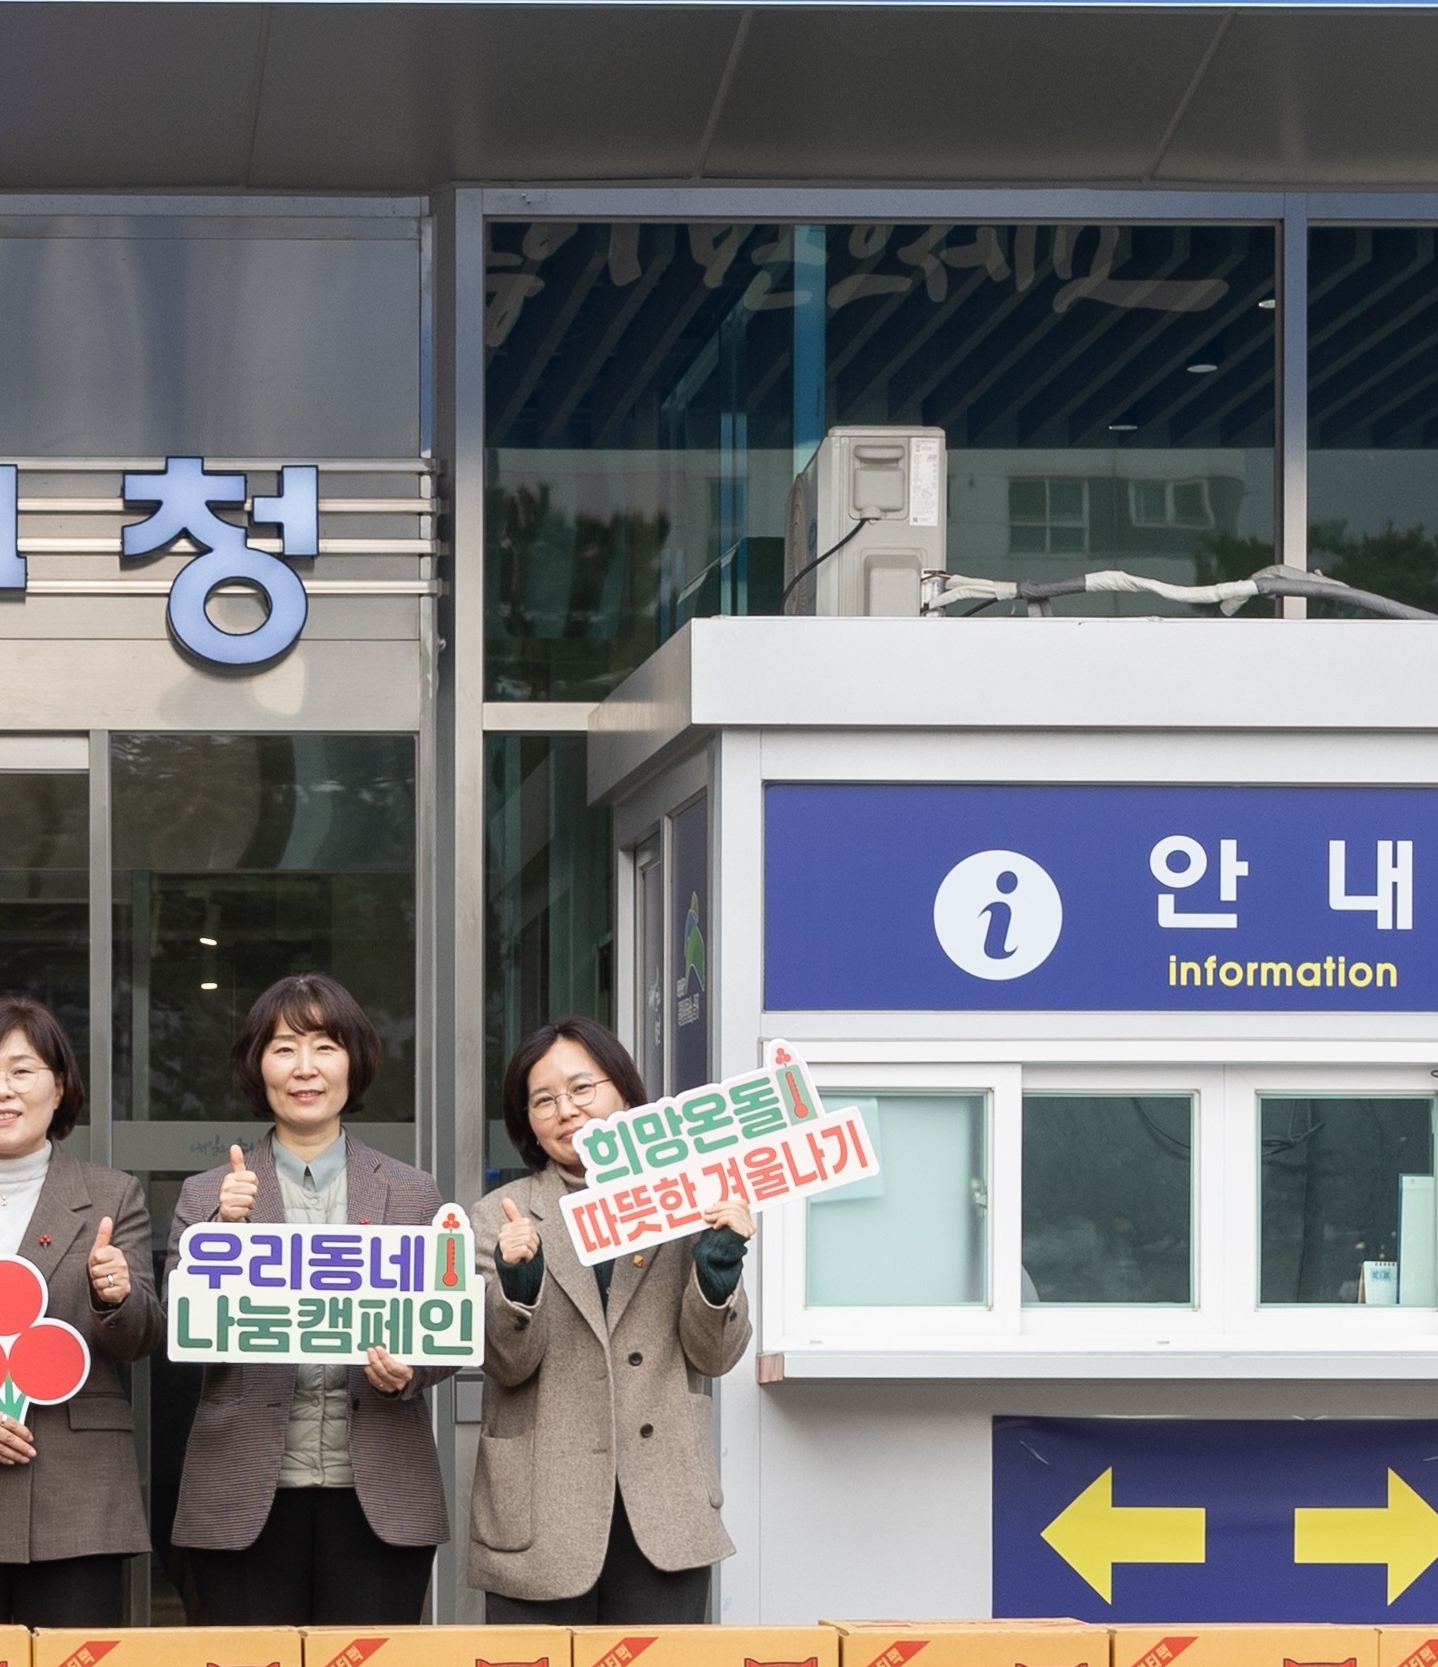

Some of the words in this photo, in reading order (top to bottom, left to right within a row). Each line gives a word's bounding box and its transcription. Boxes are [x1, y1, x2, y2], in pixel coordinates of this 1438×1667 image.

[1167, 952, 1399, 989] information
[582, 1076, 788, 1184] 희망온돌
[571, 1172, 702, 1253] 따뜻한
[702, 1119, 869, 1206] 겨울나기
[187, 1232, 425, 1292] 우리동네
[177, 1295, 474, 1356] 나눔캠페인
